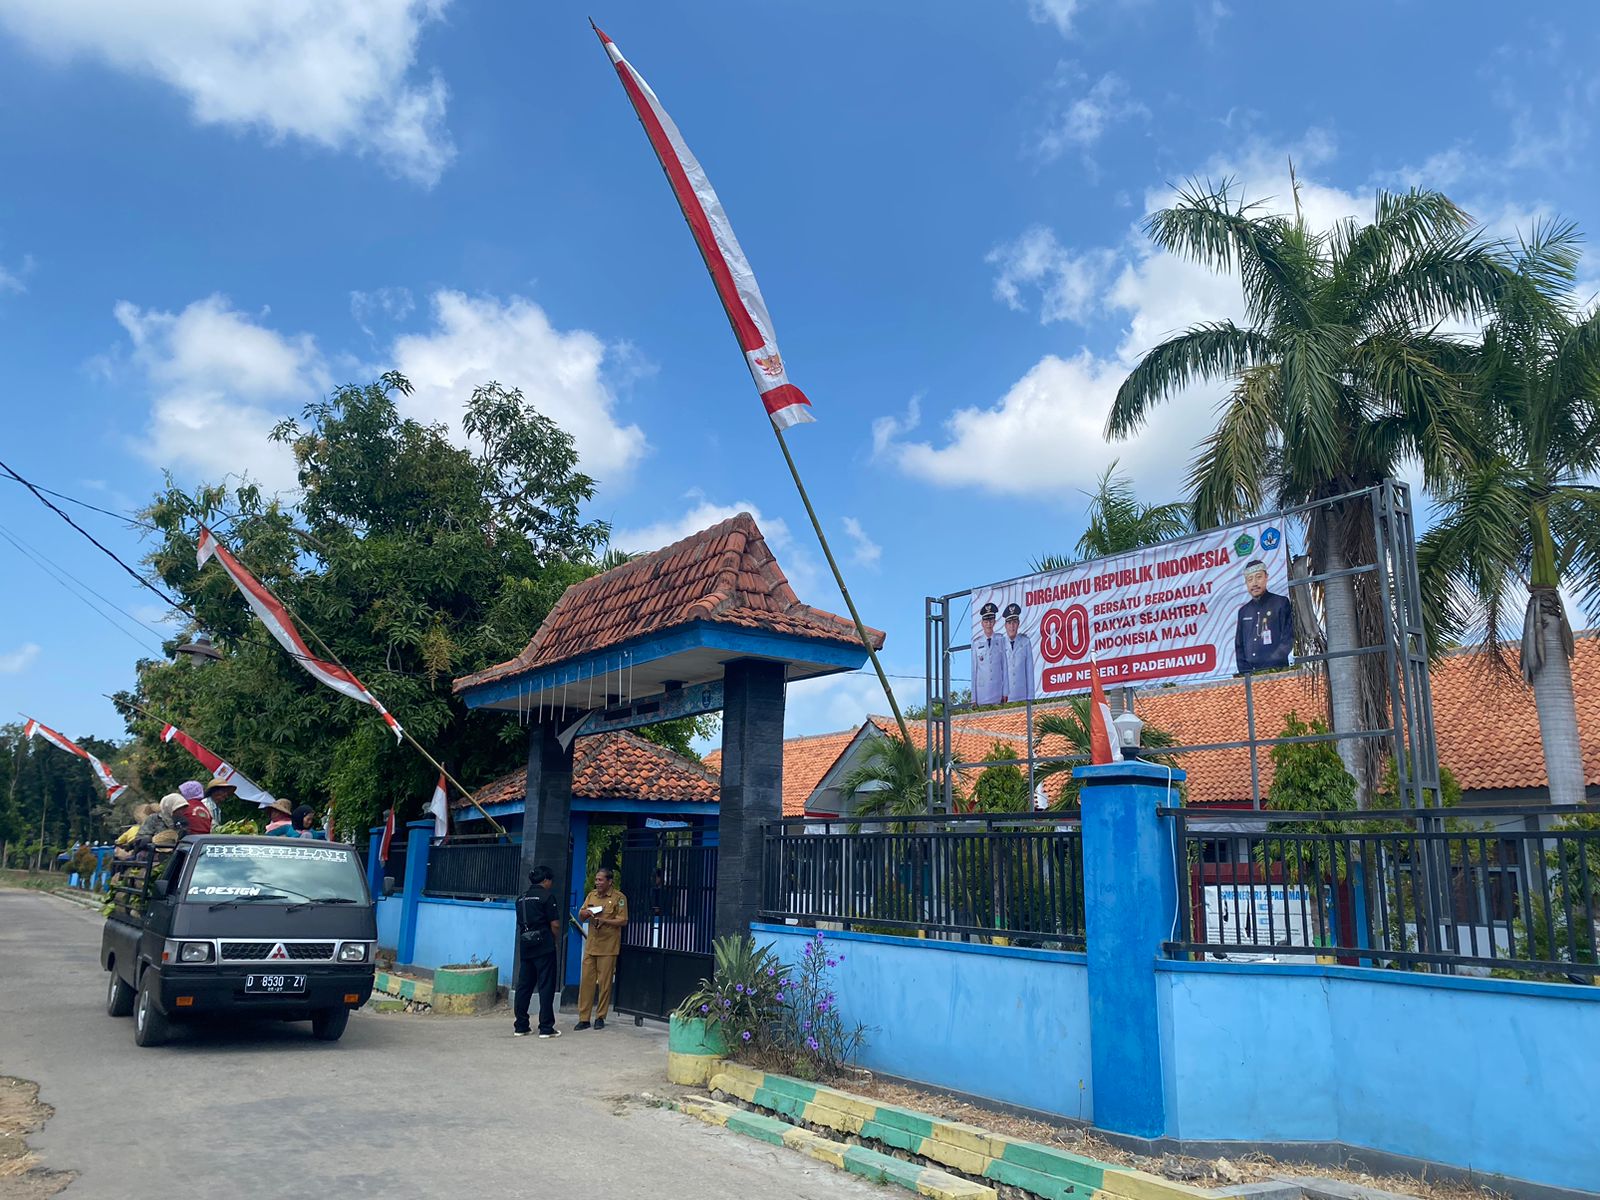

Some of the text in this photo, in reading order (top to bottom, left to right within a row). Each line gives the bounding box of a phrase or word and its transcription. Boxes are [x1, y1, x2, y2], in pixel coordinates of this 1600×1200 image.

[1025, 547, 1230, 607] DIRGAHAYU REPUBLIK INDONESIA
[1093, 581, 1213, 616] BERSATU BERDAULAT
[1041, 603, 1091, 663] 80
[1093, 602, 1208, 634] RAKYAT SEJAHTERA
[1094, 622, 1198, 652] INDONESIA MAJU
[1049, 672, 1073, 685] SMP
[1121, 663, 1129, 675] 2
[1132, 652, 1206, 674] PADEMAWU
[206, 845, 347, 861] BISMILLAH
[247, 976, 305, 987] D 8530 ZY
